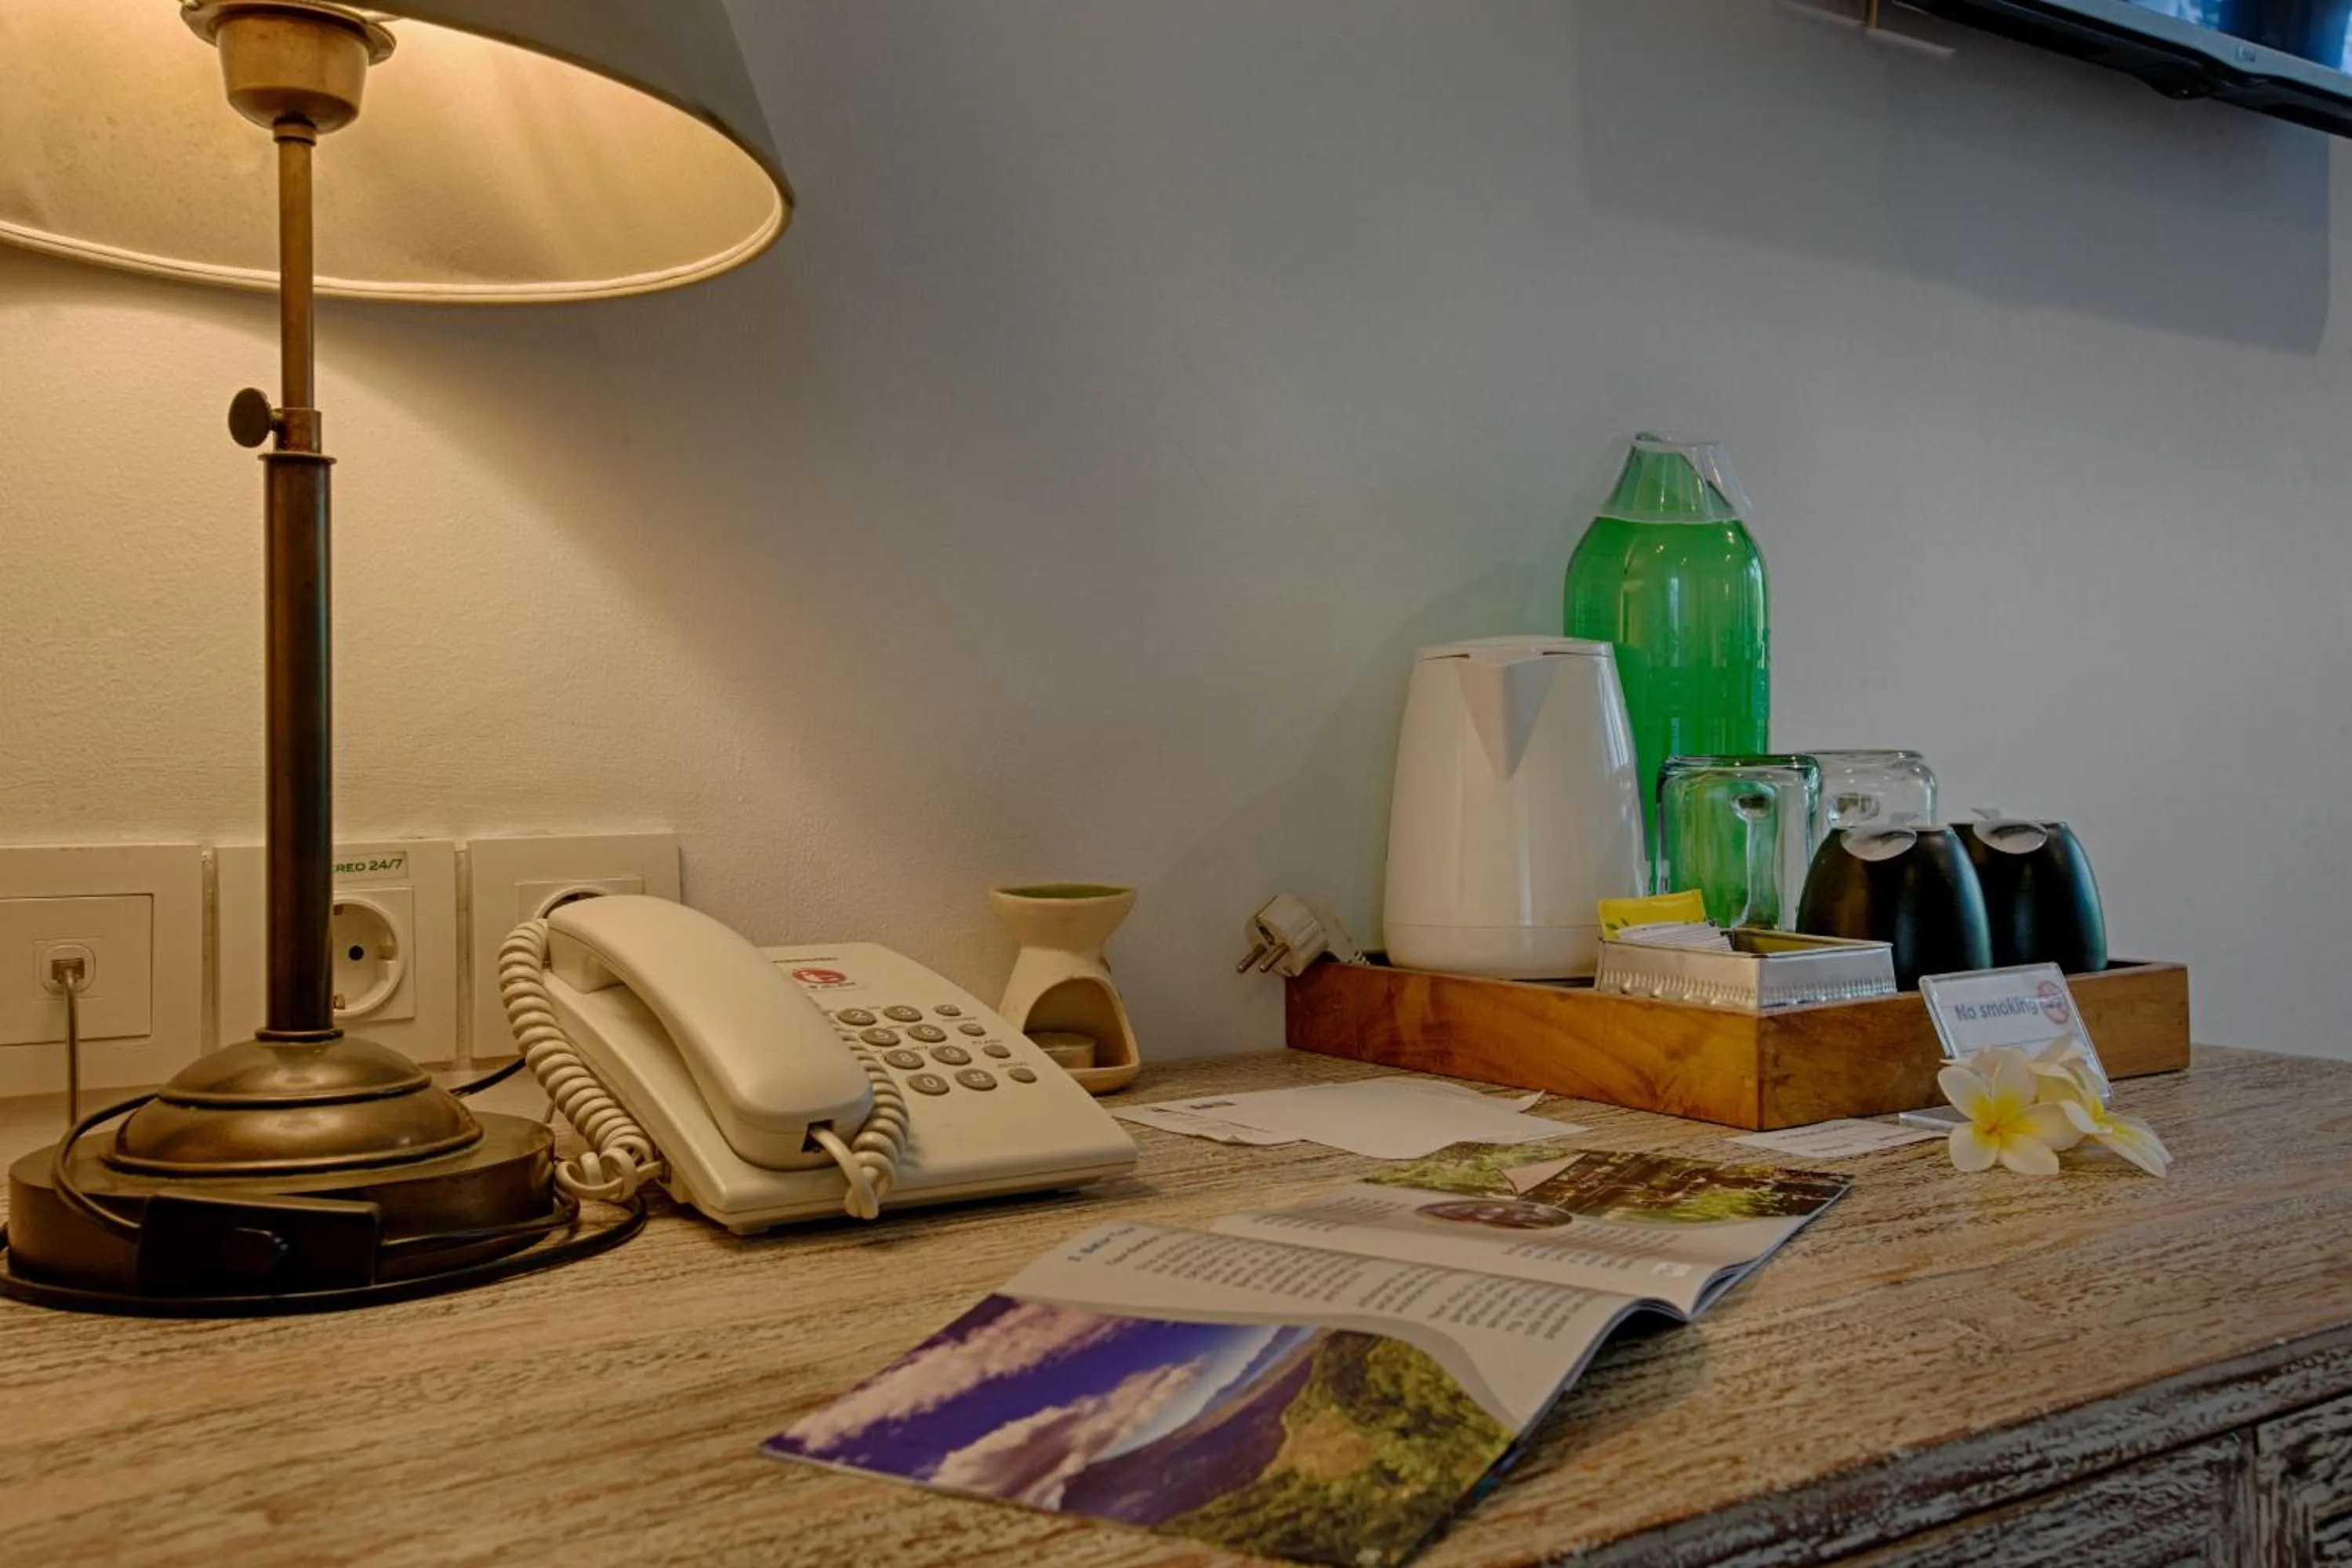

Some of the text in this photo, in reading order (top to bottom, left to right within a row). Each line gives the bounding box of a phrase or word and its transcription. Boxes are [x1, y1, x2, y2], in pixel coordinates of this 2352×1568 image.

[333, 858, 402, 873] RED 24/7
[1955, 997, 2038, 1022] No smoking
[923, 1076, 938, 1087] 0
